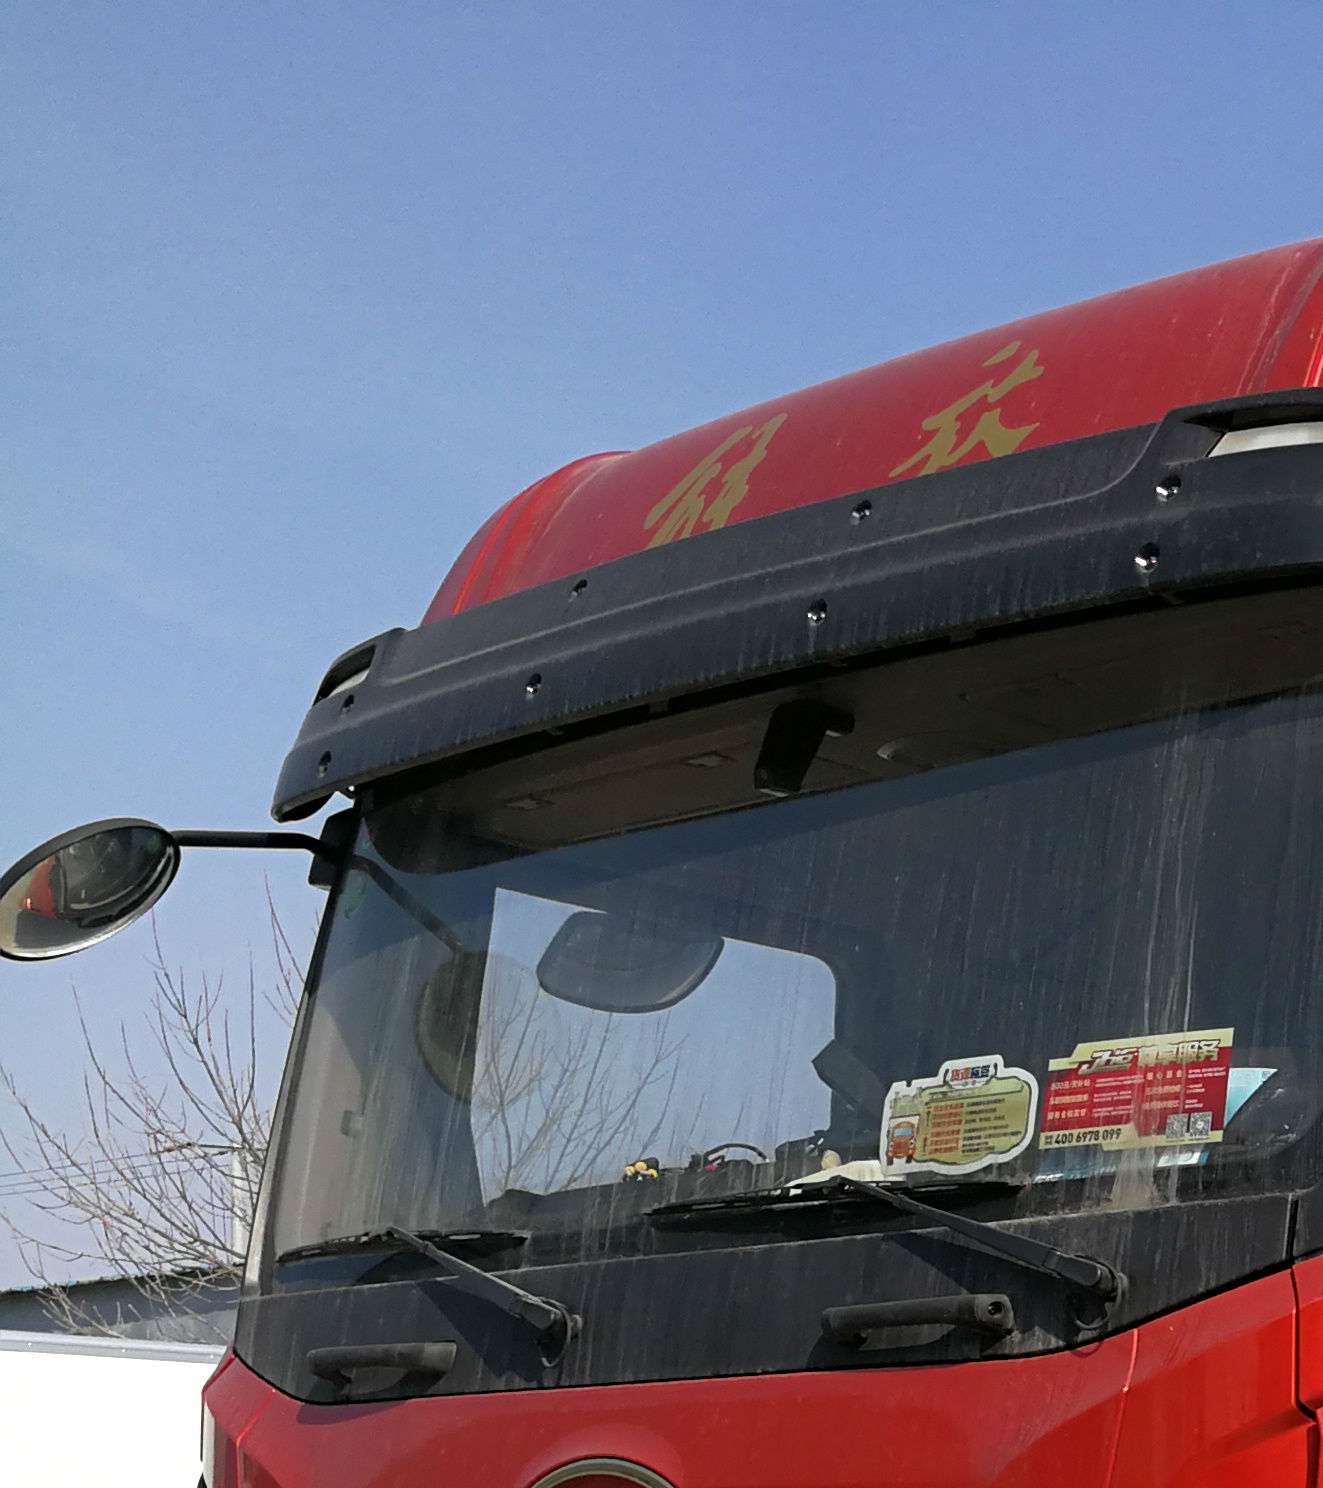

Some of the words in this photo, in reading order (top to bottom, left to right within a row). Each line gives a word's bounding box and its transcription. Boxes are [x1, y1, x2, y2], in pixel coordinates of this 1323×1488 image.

[1054, 1133, 1073, 1145] 400
[1075, 1130, 1100, 1143] 6978
[1102, 1128, 1122, 1140] 099
